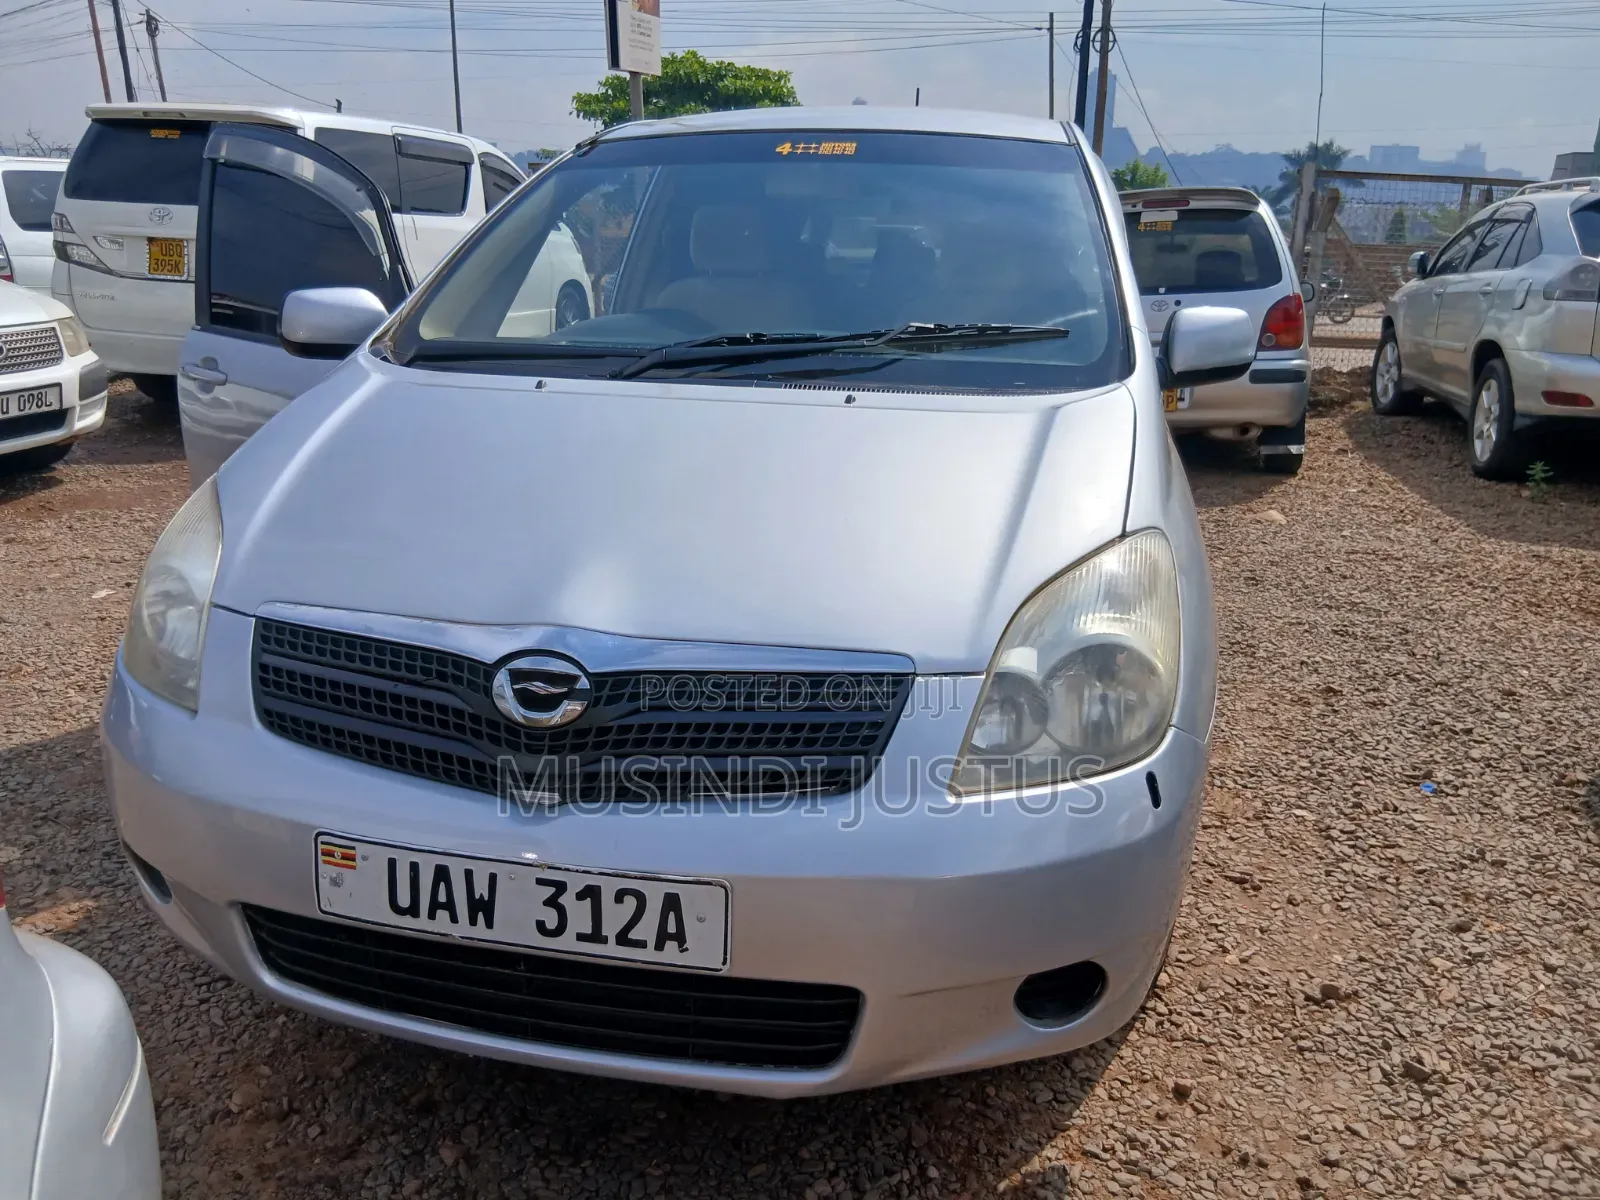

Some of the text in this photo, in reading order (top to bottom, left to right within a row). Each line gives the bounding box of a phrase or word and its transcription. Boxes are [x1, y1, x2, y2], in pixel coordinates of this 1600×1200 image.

[160, 242, 183, 258] UBQ
[152, 258, 181, 274] 395K
[17, 390, 53, 413] 098L
[387, 856, 690, 953] UAW 312A
